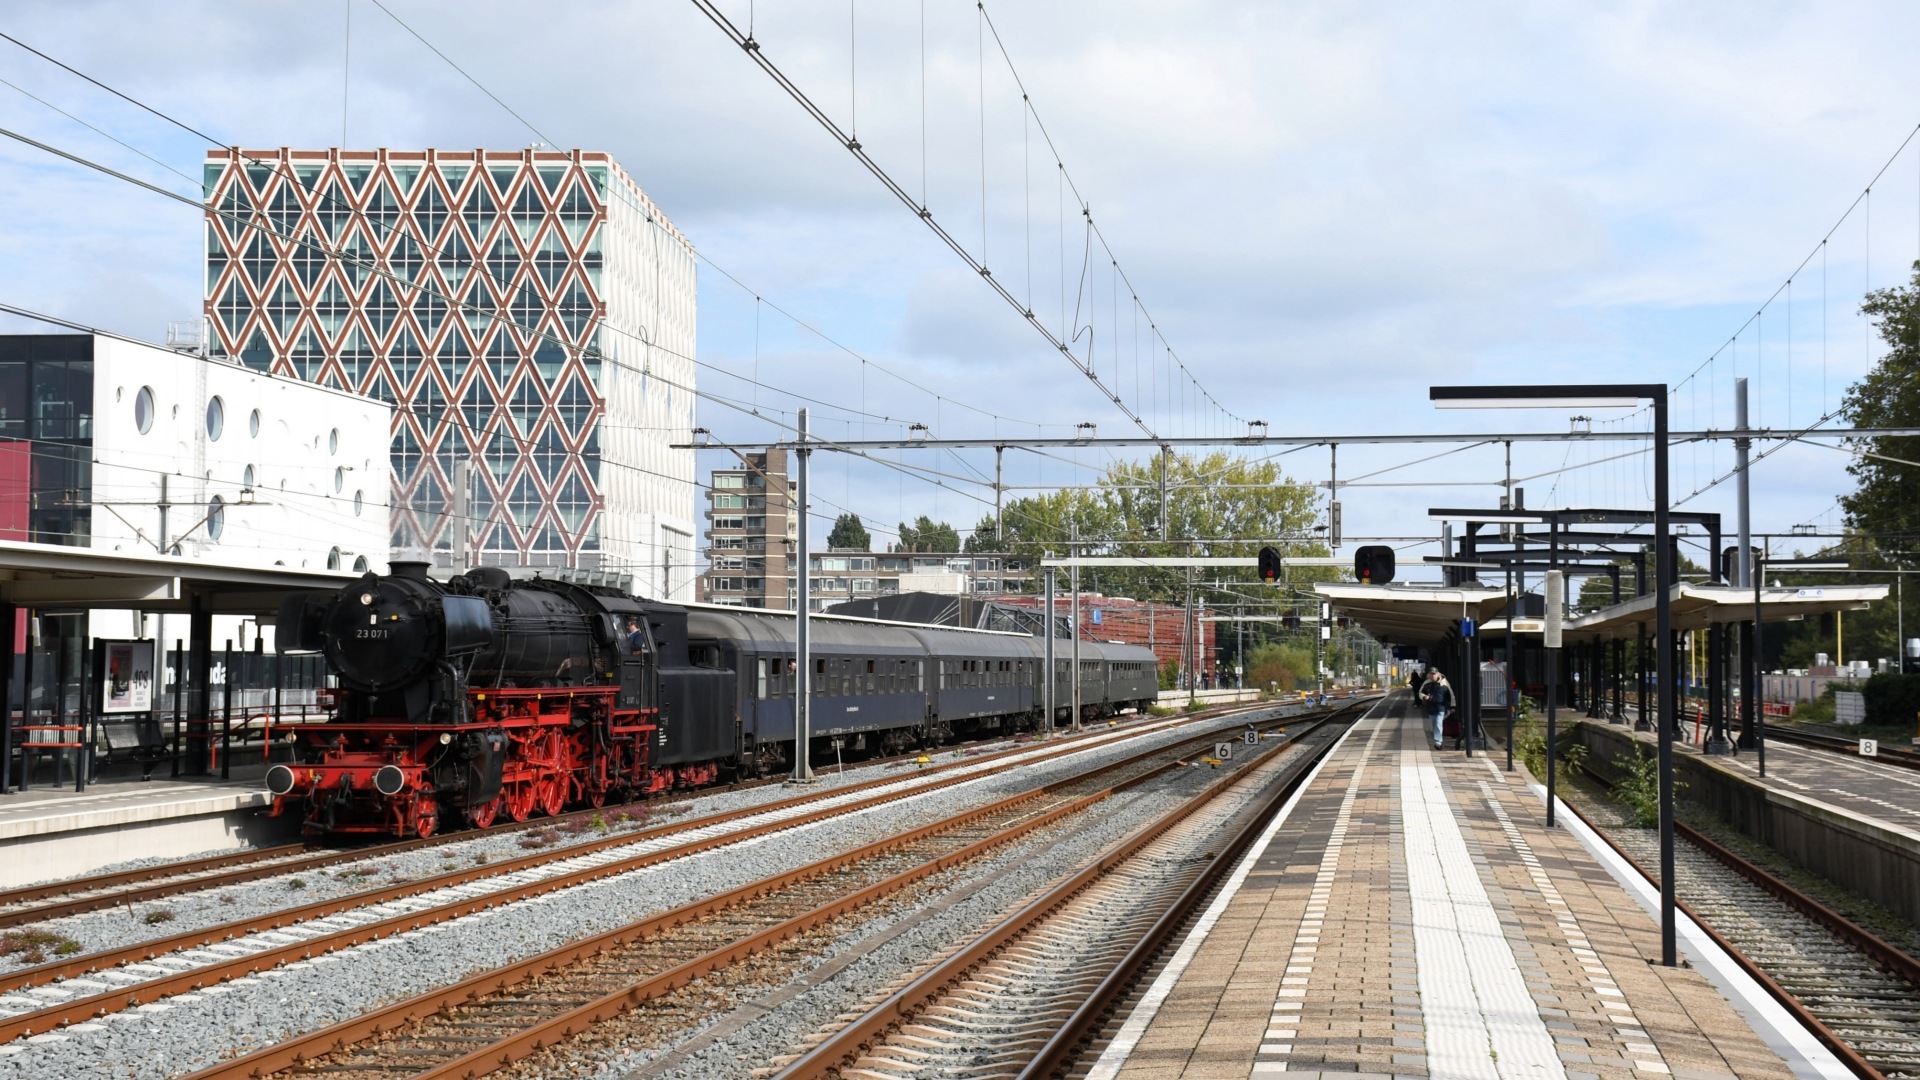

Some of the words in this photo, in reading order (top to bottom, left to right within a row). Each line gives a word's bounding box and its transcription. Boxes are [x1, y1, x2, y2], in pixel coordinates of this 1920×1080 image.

[357, 629, 369, 638] 23
[371, 629, 388, 638] 071
[1247, 732, 1256, 743] 8
[1219, 744, 1229, 757] 6
[1864, 741, 1873, 753] 8
